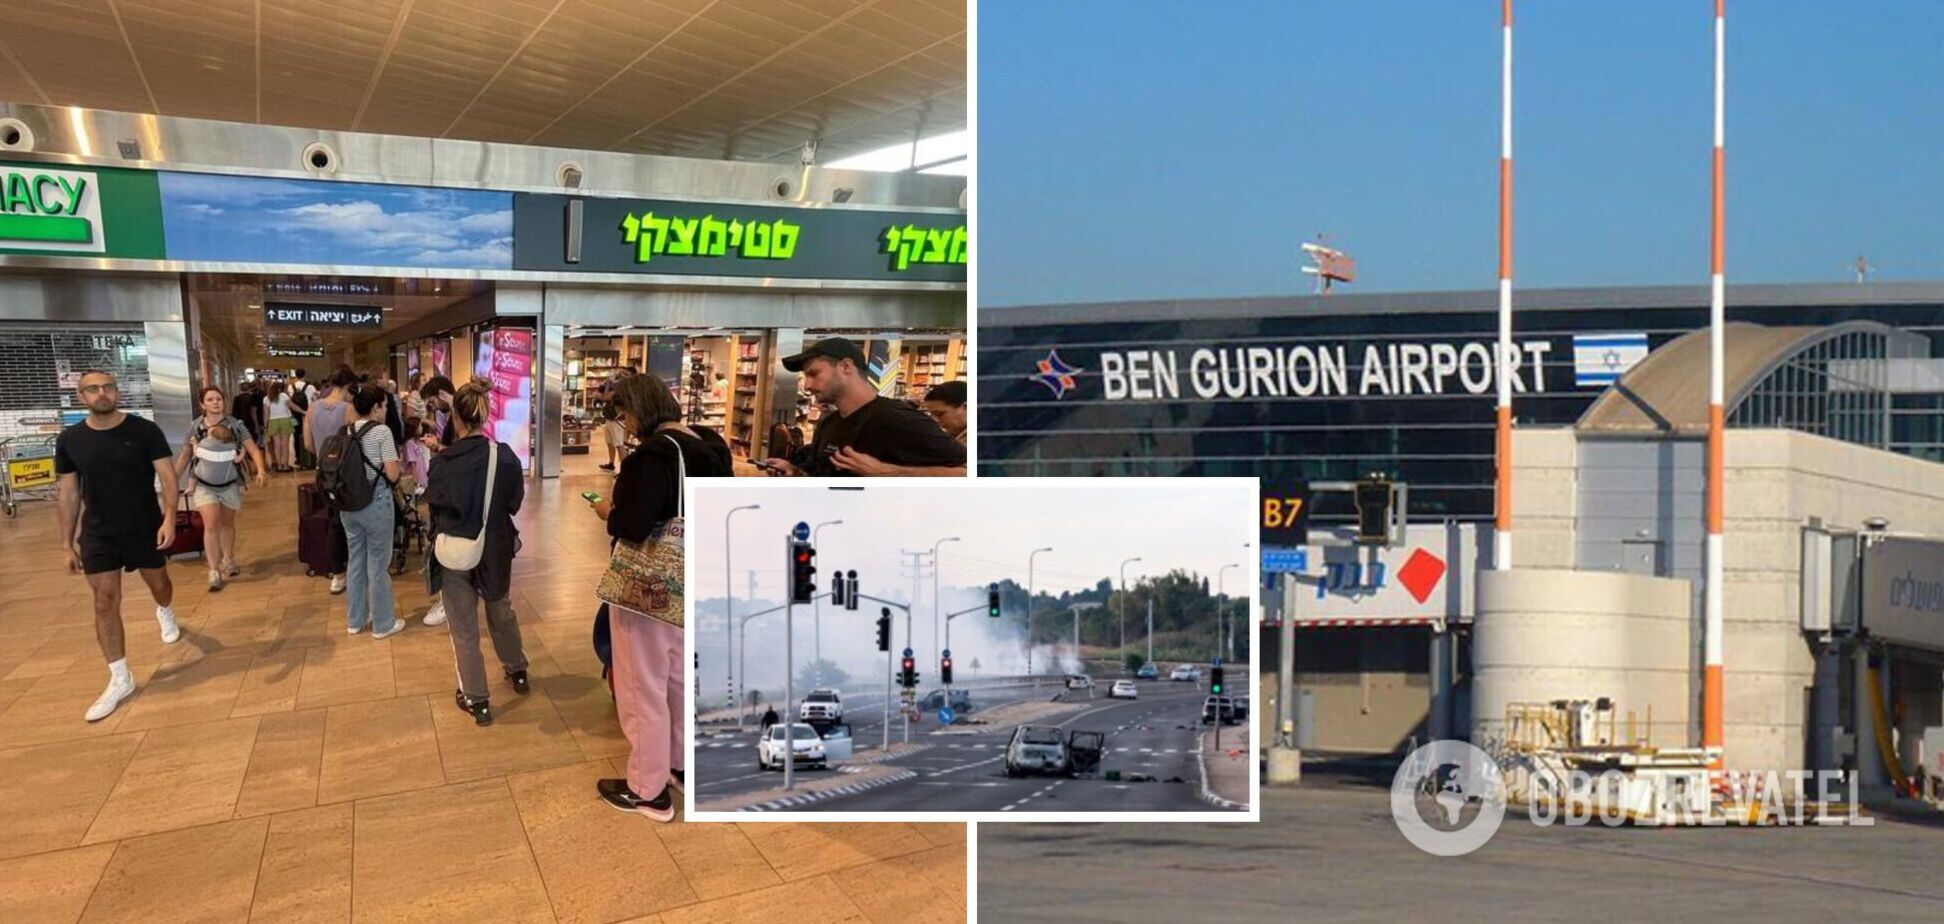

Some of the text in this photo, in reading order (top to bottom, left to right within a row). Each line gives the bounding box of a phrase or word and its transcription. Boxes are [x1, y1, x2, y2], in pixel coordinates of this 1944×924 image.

[0, 172, 87, 216] ACY
[622, 211, 800, 262] סטימצקי
[277, 309, 303, 321] EXIT
[310, 311, 345, 322] יציאה
[1100, 340, 1552, 401] BEN GURION AIRPORT
[1263, 497, 1303, 528] B7
